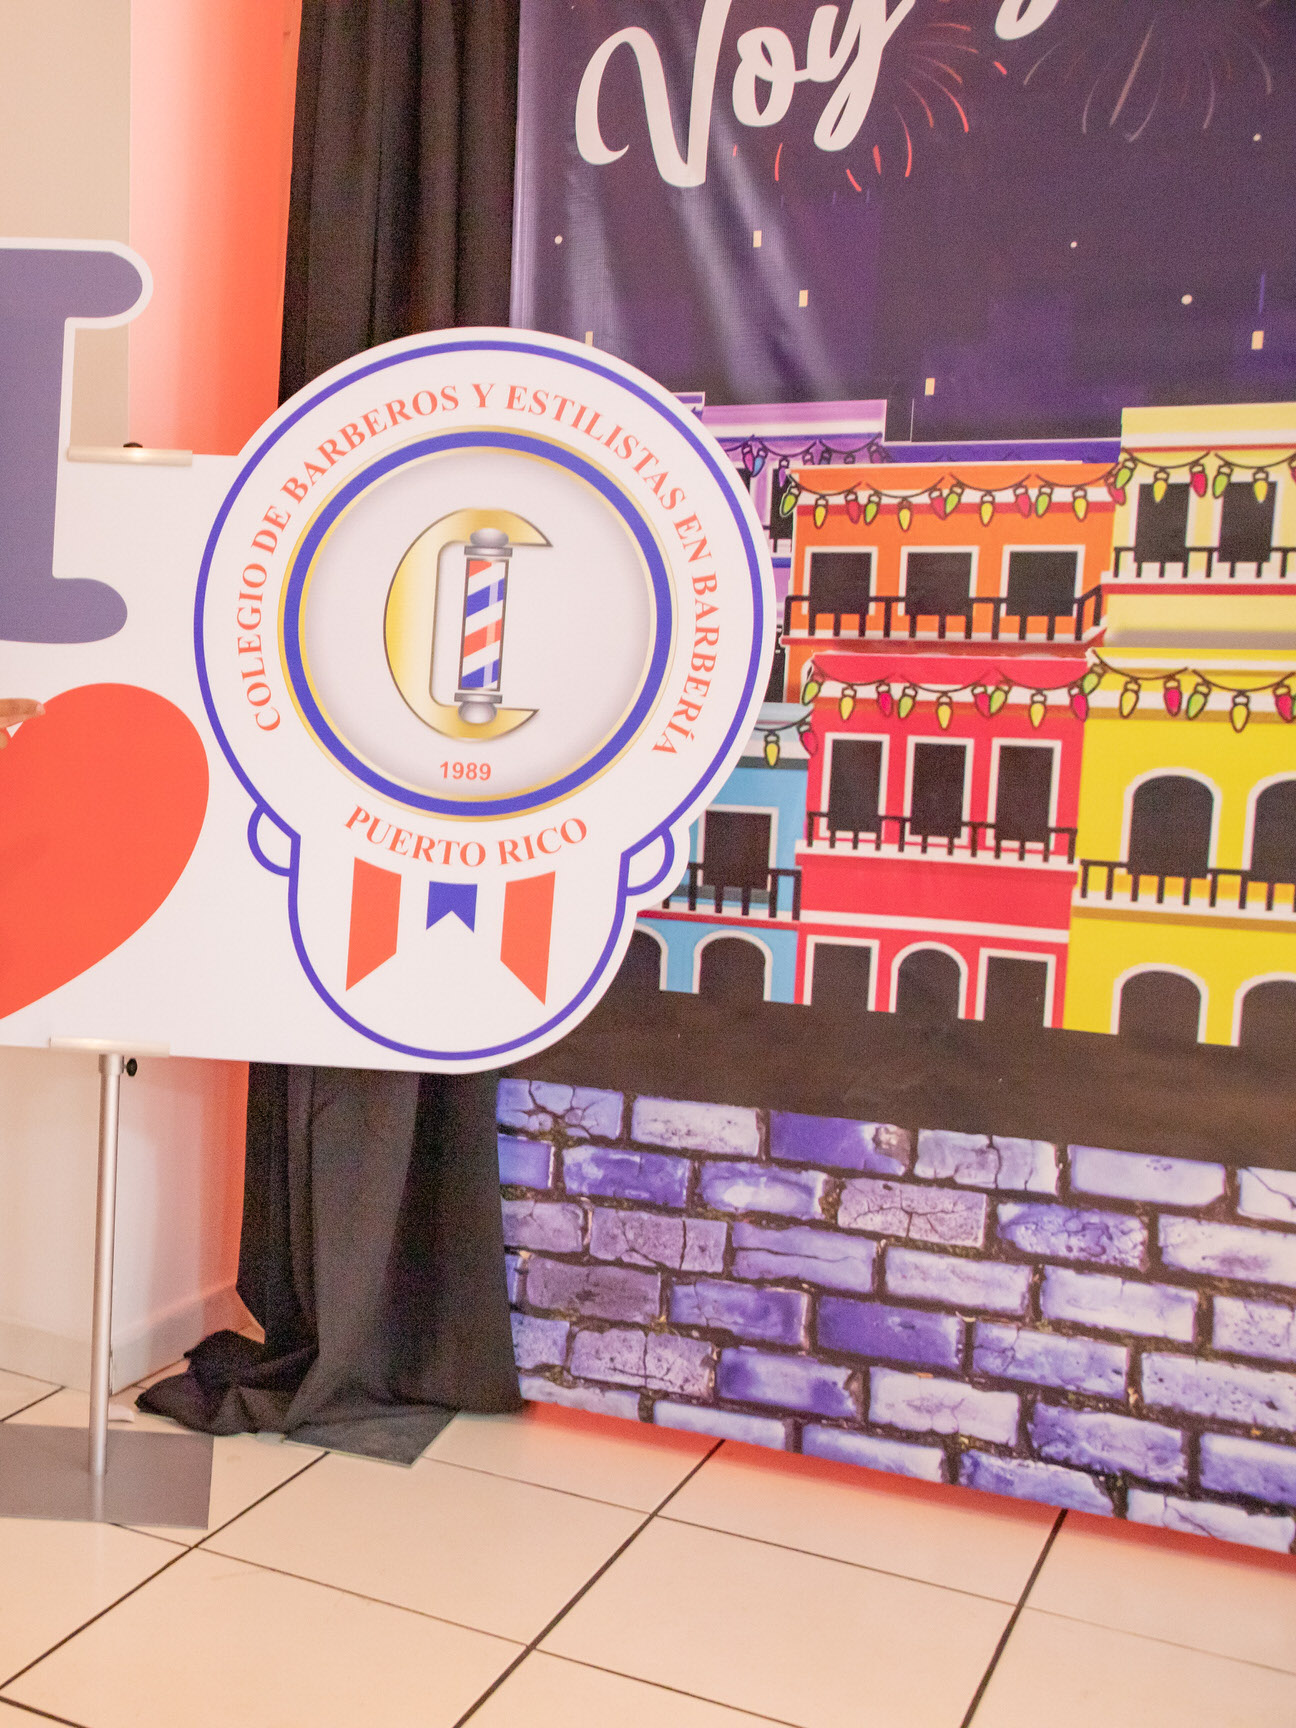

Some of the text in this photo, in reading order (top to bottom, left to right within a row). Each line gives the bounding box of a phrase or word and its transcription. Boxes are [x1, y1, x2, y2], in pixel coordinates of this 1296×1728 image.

[575, 0, 914, 188] Voy
[236, 382, 721, 755] COLEGIO DE BARBEROS Y ESTILISTAS EN BARBERÍA
[438, 759, 493, 782] 1989
[344, 804, 588, 868] PUERTO RICO
